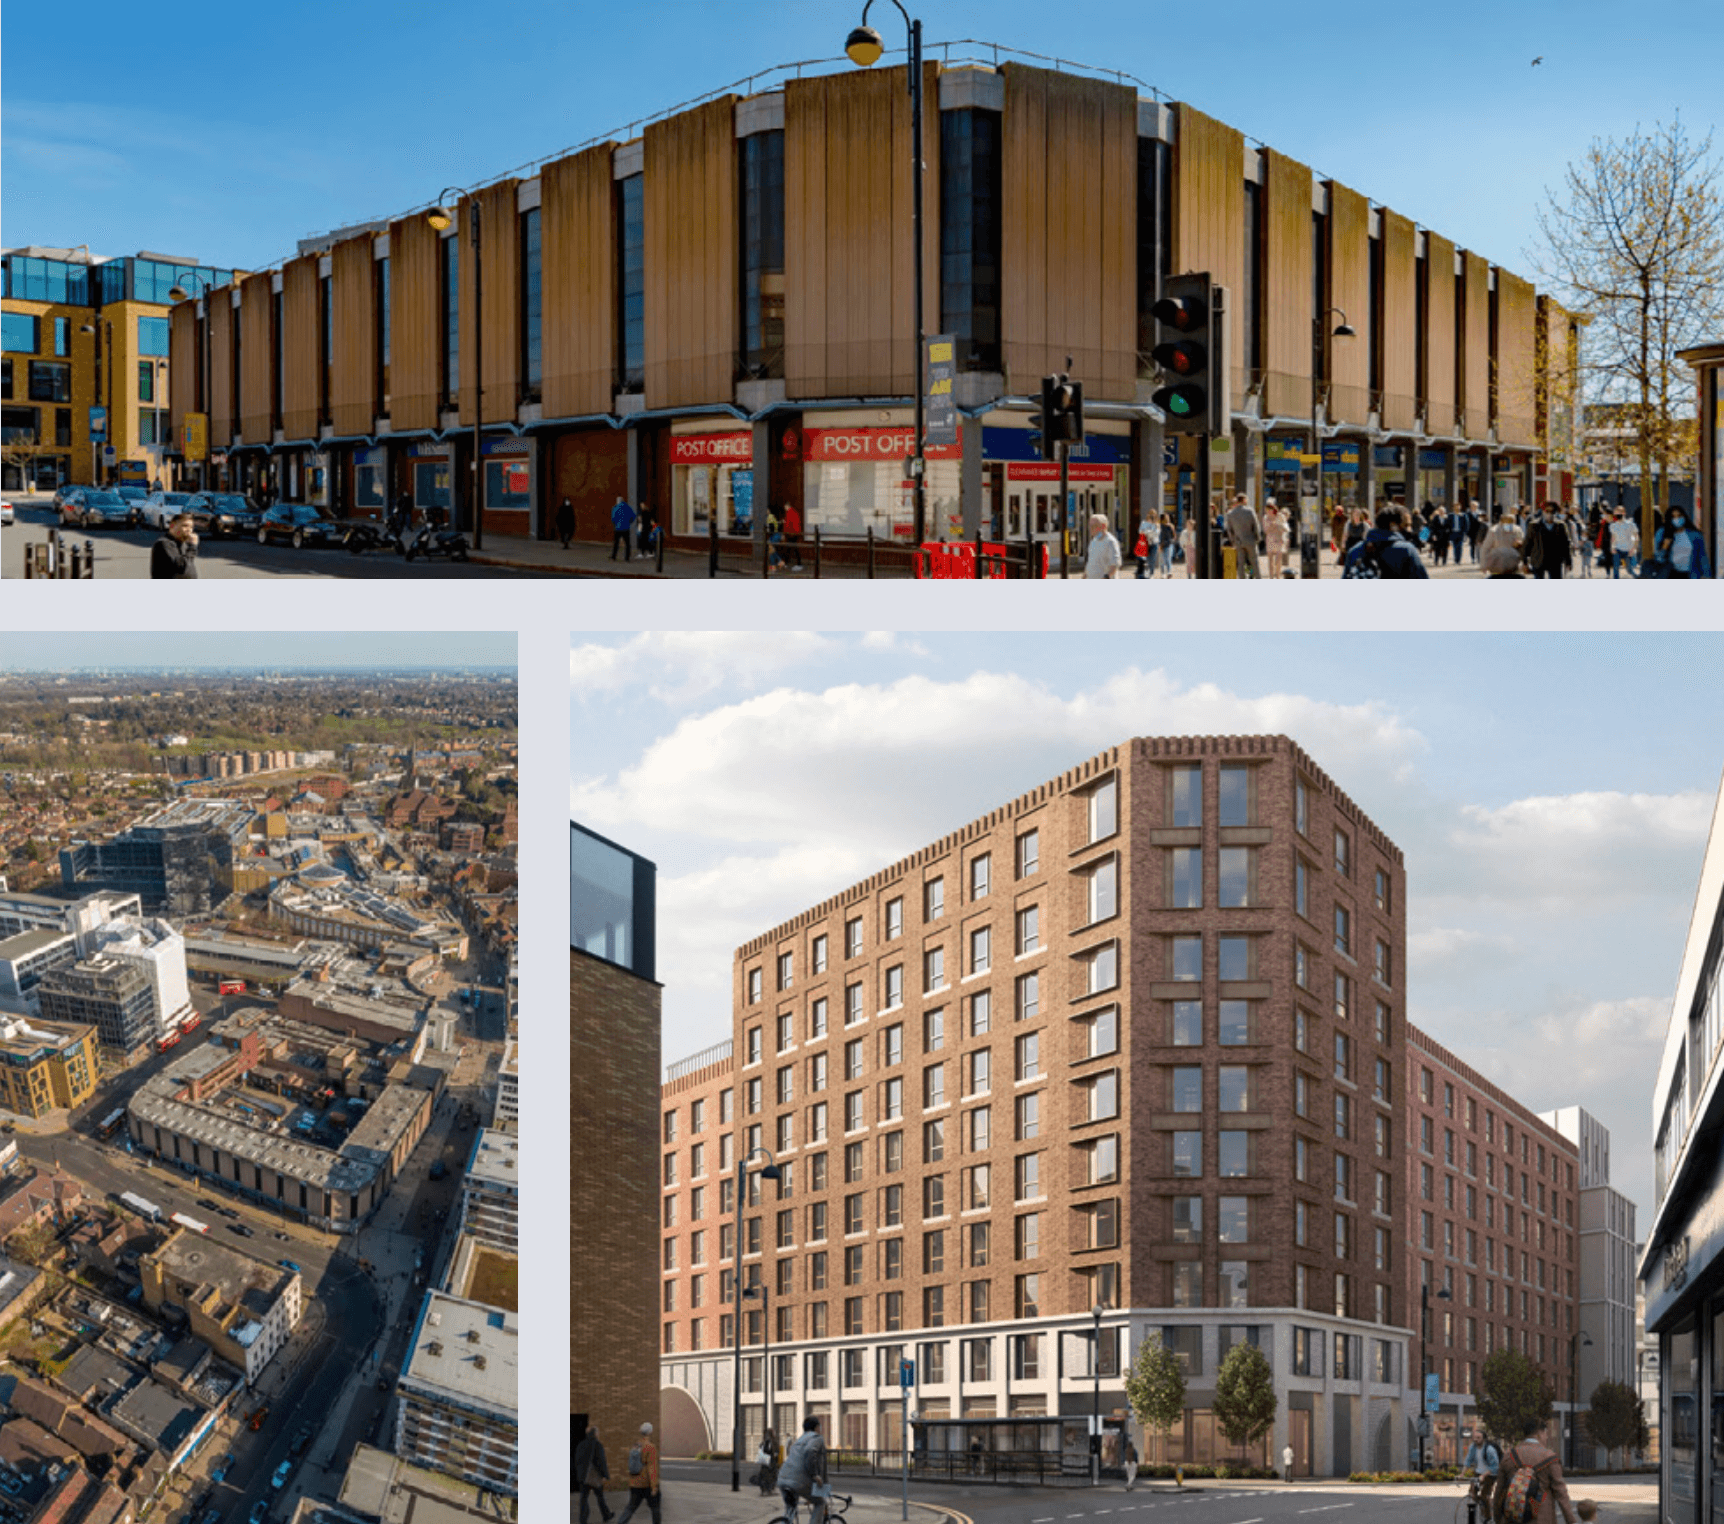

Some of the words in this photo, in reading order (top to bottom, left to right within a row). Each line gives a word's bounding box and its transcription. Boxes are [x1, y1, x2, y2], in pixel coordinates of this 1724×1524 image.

[677, 440, 706, 457] POST
[707, 437, 751, 456] OFFICE
[824, 436, 872, 454] POST
[877, 435, 947, 453] OFF
